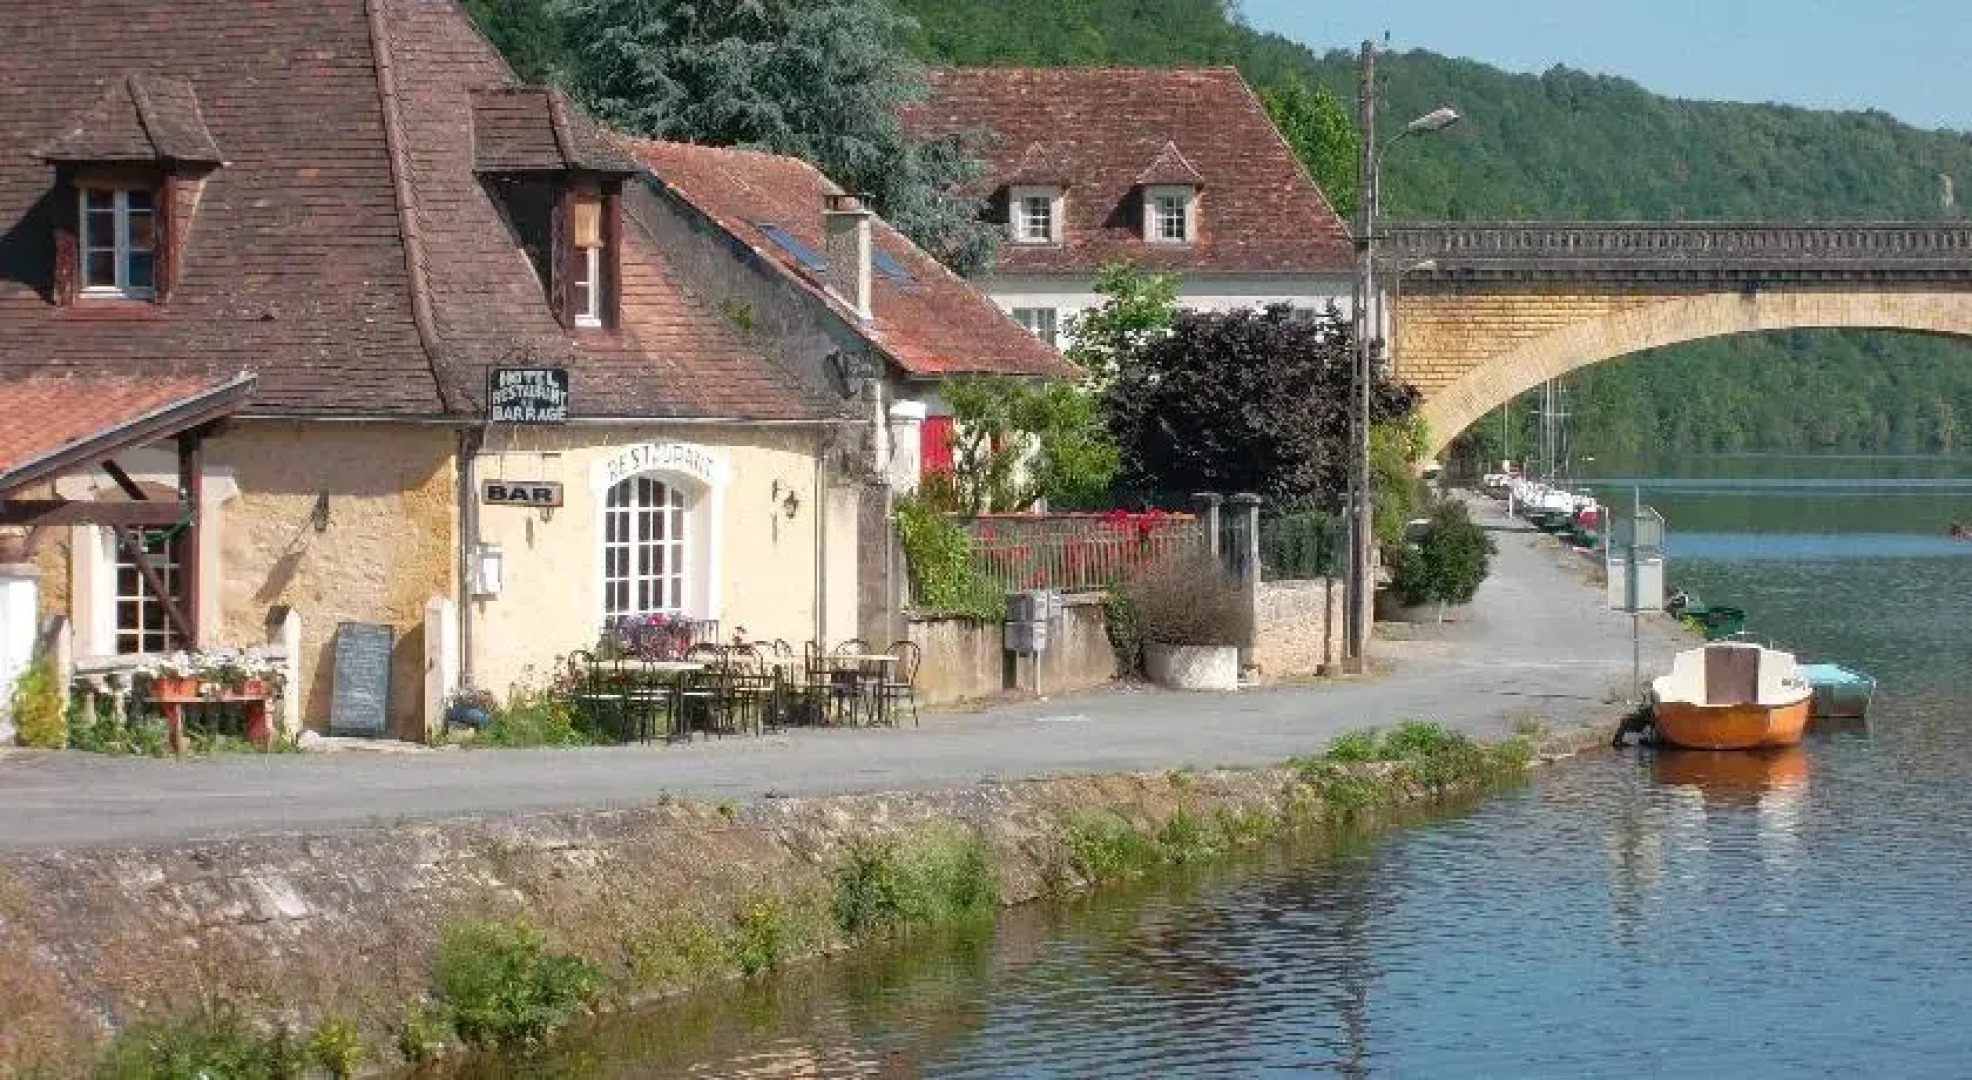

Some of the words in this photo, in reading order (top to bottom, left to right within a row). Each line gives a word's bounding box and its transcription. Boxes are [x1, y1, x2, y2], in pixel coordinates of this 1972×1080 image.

[499, 371, 560, 387] HOTEL
[492, 385, 567, 406] RESTAURANT
[492, 405, 568, 421] BARRAGE
[487, 485, 552, 502] BAR
